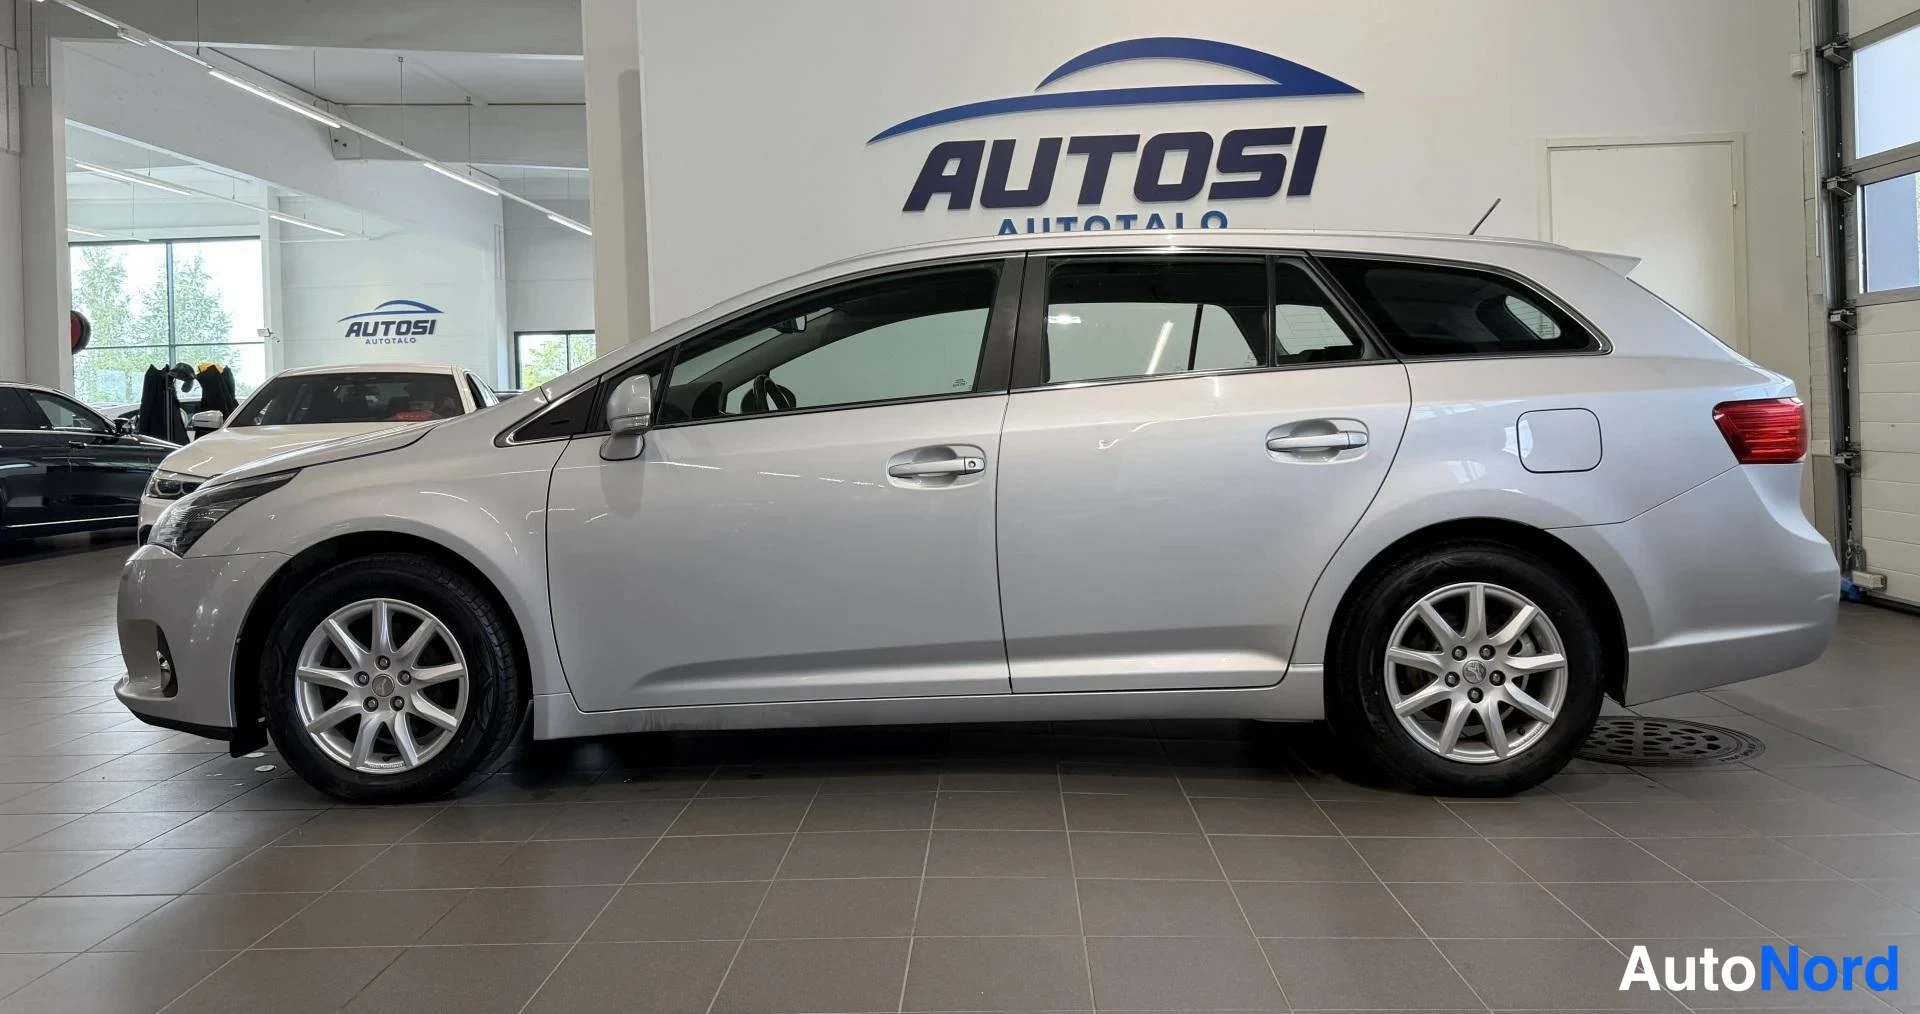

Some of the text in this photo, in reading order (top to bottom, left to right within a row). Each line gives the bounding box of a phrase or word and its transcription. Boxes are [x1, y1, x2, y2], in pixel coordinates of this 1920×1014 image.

[902, 125, 1328, 212] AUTOSI
[345, 319, 437, 338] AUTOSI
[365, 337, 417, 345] AUTOTALO
